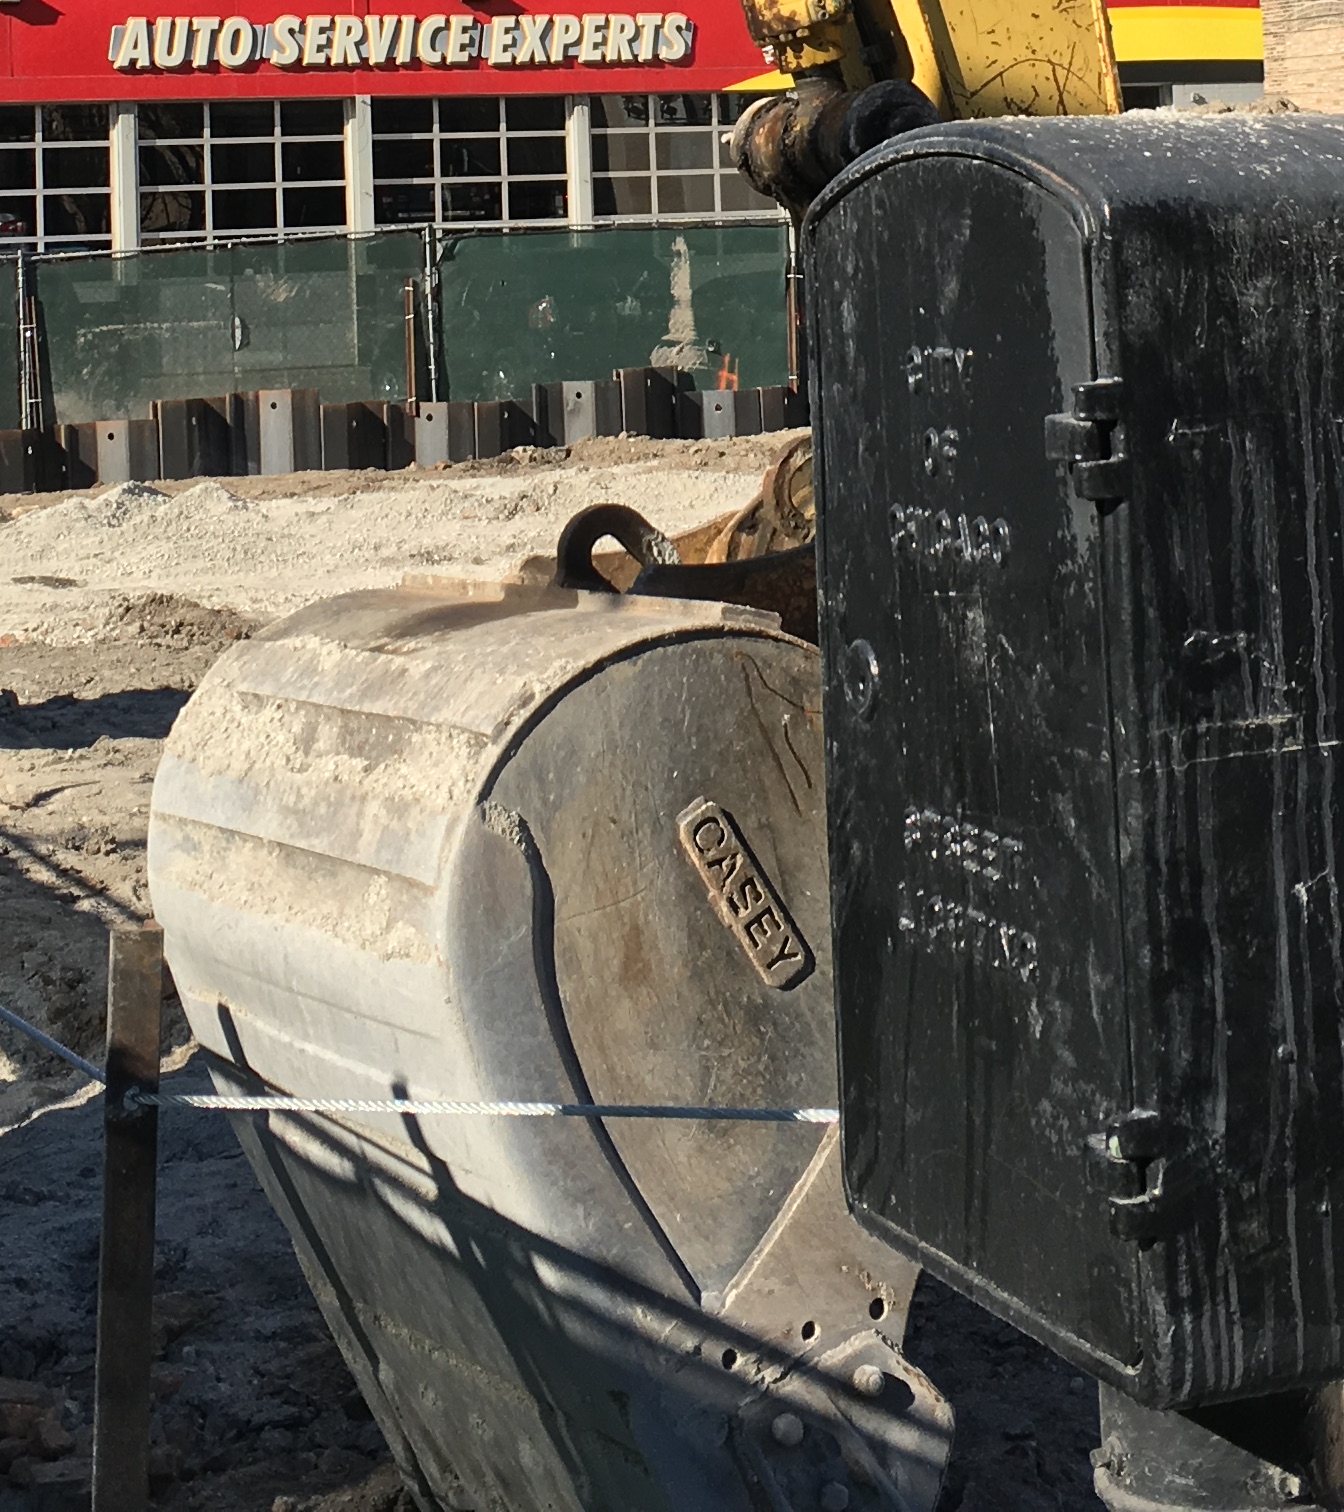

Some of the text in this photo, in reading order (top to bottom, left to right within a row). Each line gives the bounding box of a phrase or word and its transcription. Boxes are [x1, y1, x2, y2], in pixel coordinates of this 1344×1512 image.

[113, 13, 693, 70] AUTO SERVICE EXPERTS
[693, 816, 802, 970] CASEY
